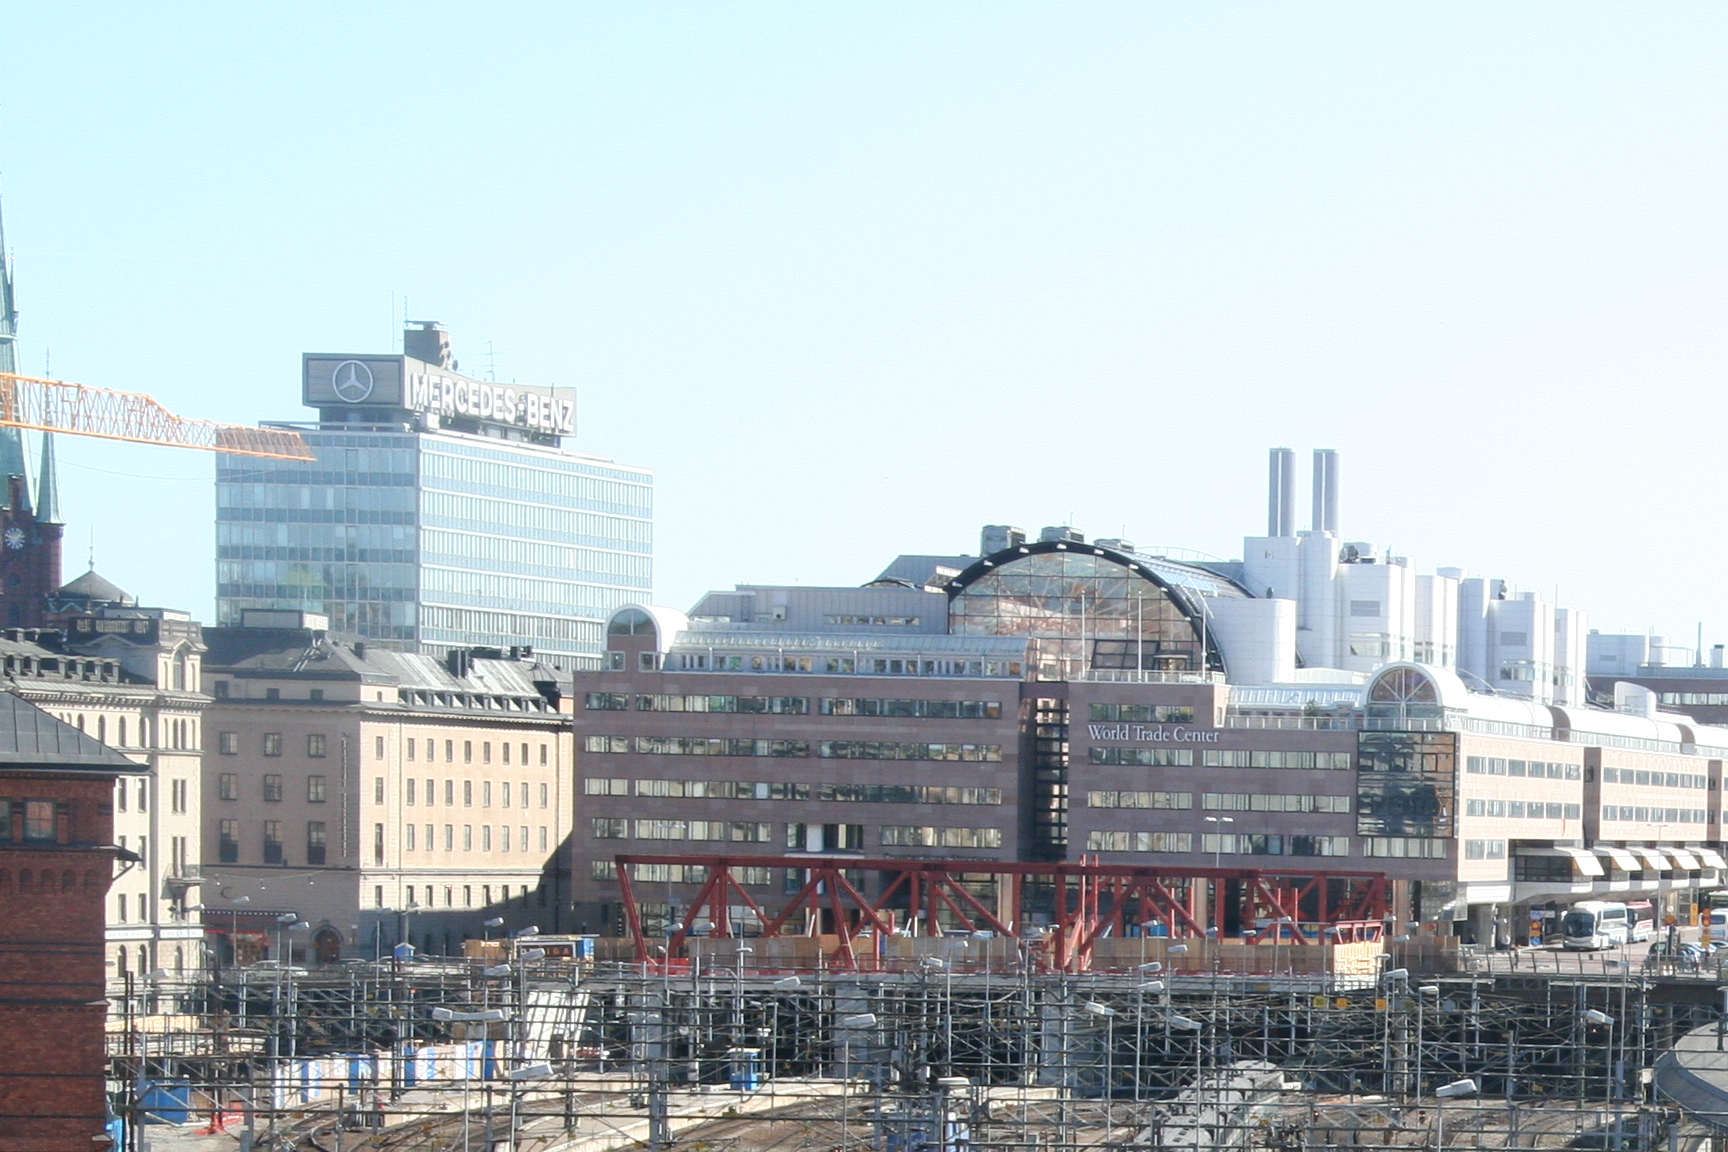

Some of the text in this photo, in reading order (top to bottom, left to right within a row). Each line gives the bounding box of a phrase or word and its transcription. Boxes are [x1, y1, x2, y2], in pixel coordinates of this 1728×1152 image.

[411, 372, 575, 432] MERCEDES-BENZ
[1088, 724, 1220, 743] World Trade Center
